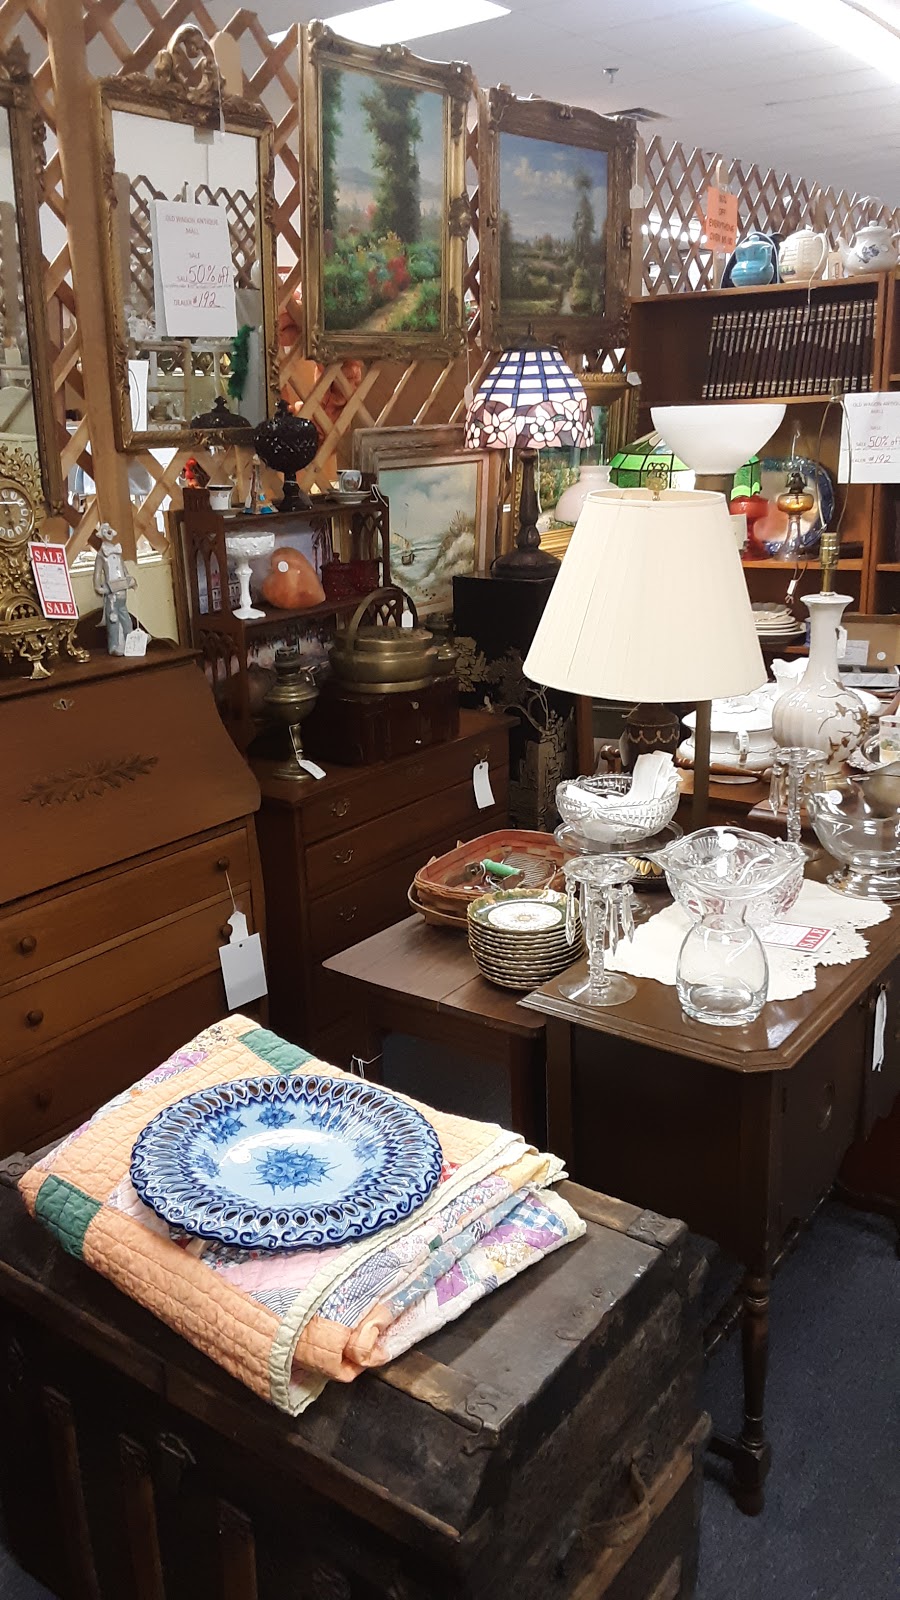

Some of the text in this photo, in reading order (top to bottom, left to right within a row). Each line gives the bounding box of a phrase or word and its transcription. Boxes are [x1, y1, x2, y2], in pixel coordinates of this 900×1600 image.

[196, 217, 219, 226] ANTIQUE
[188, 264, 216, 284] 50%
[868, 435, 889, 448] 50%
[34, 550, 64, 563] SALE
[46, 602, 75, 615] SALE
[800, 928, 828, 948] SALE
